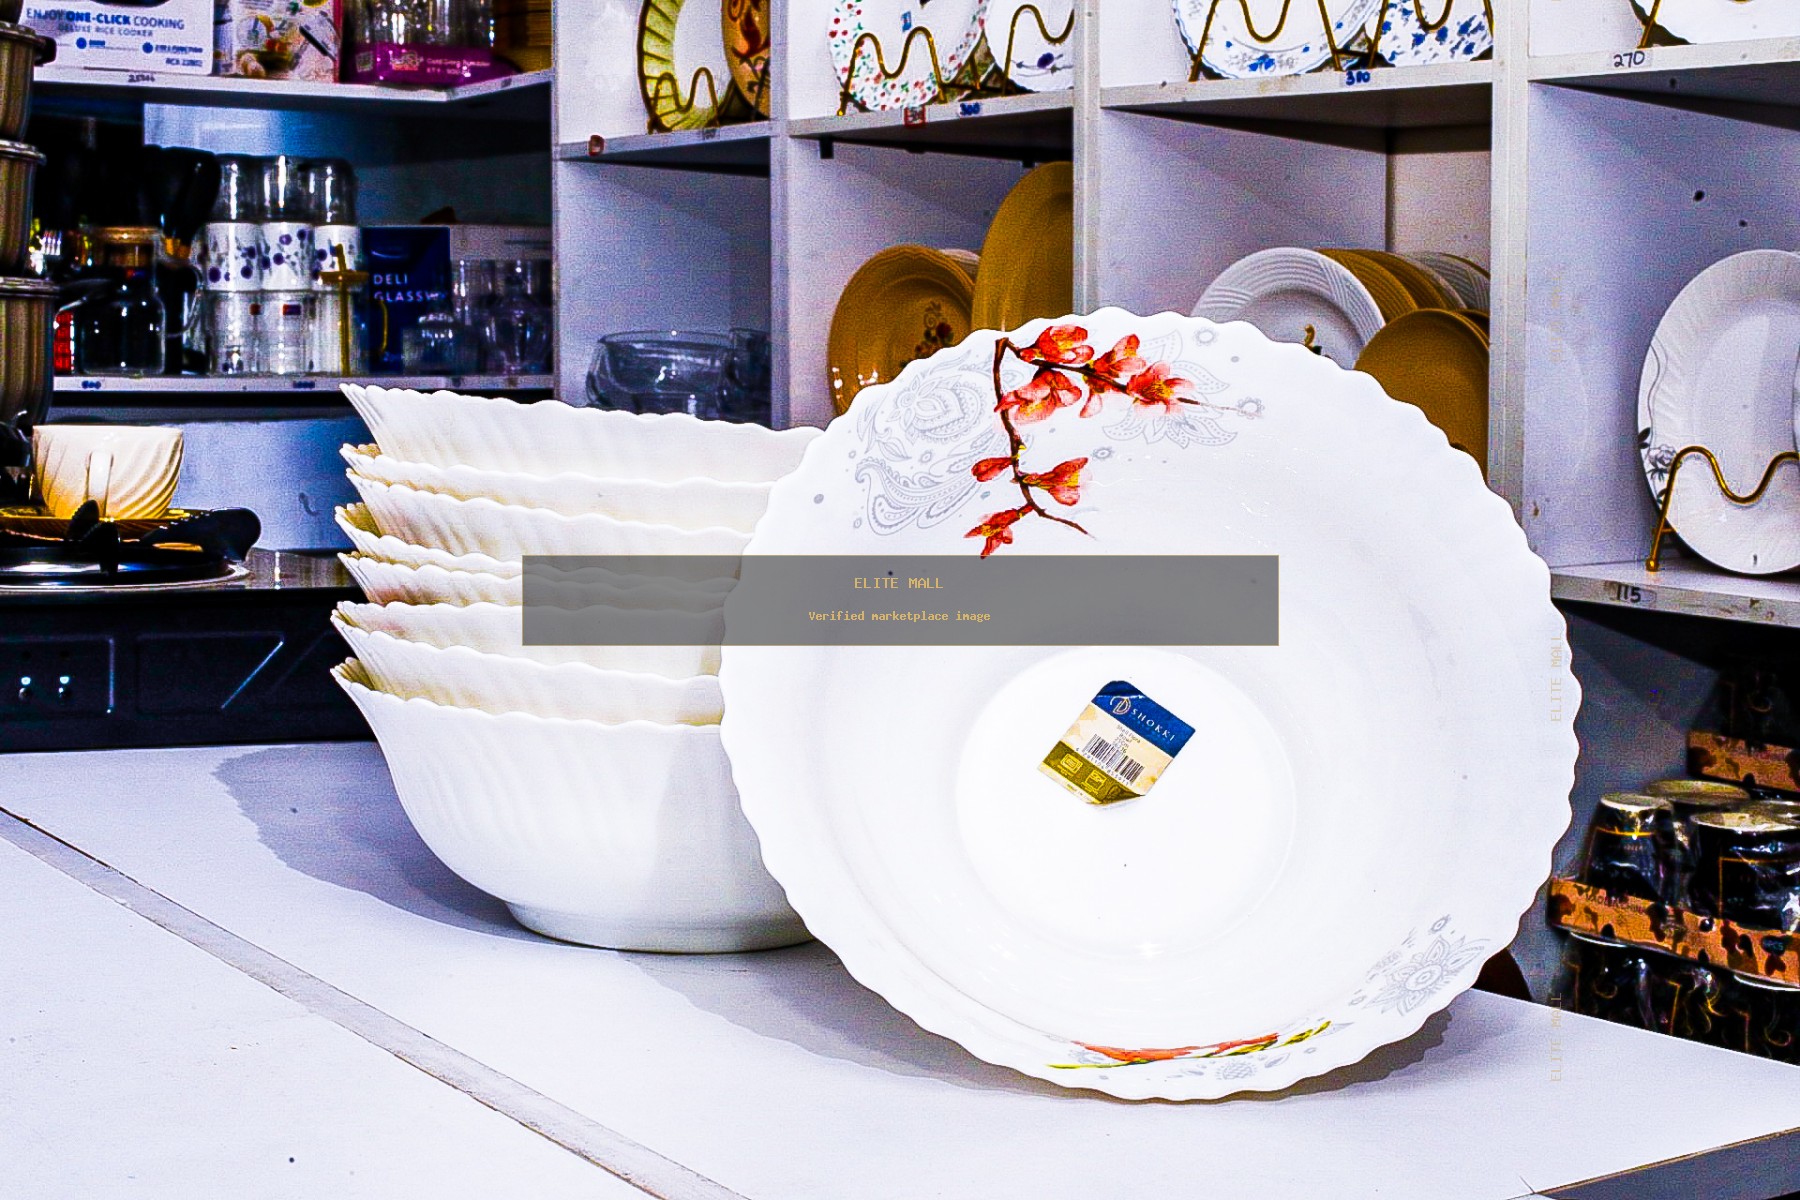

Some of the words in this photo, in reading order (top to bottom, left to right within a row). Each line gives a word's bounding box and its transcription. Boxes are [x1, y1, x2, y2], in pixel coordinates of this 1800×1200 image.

[26, 8, 64, 21] ENJOY
[66, 11, 131, 25] ONE-CLICK
[134, 16, 185, 30] COOKING
[95, 26, 115, 35] RICE
[1613, 50, 1646, 68] 270
[373, 273, 408, 285] DELI
[1132, 708, 1175, 741] SHOKKI
